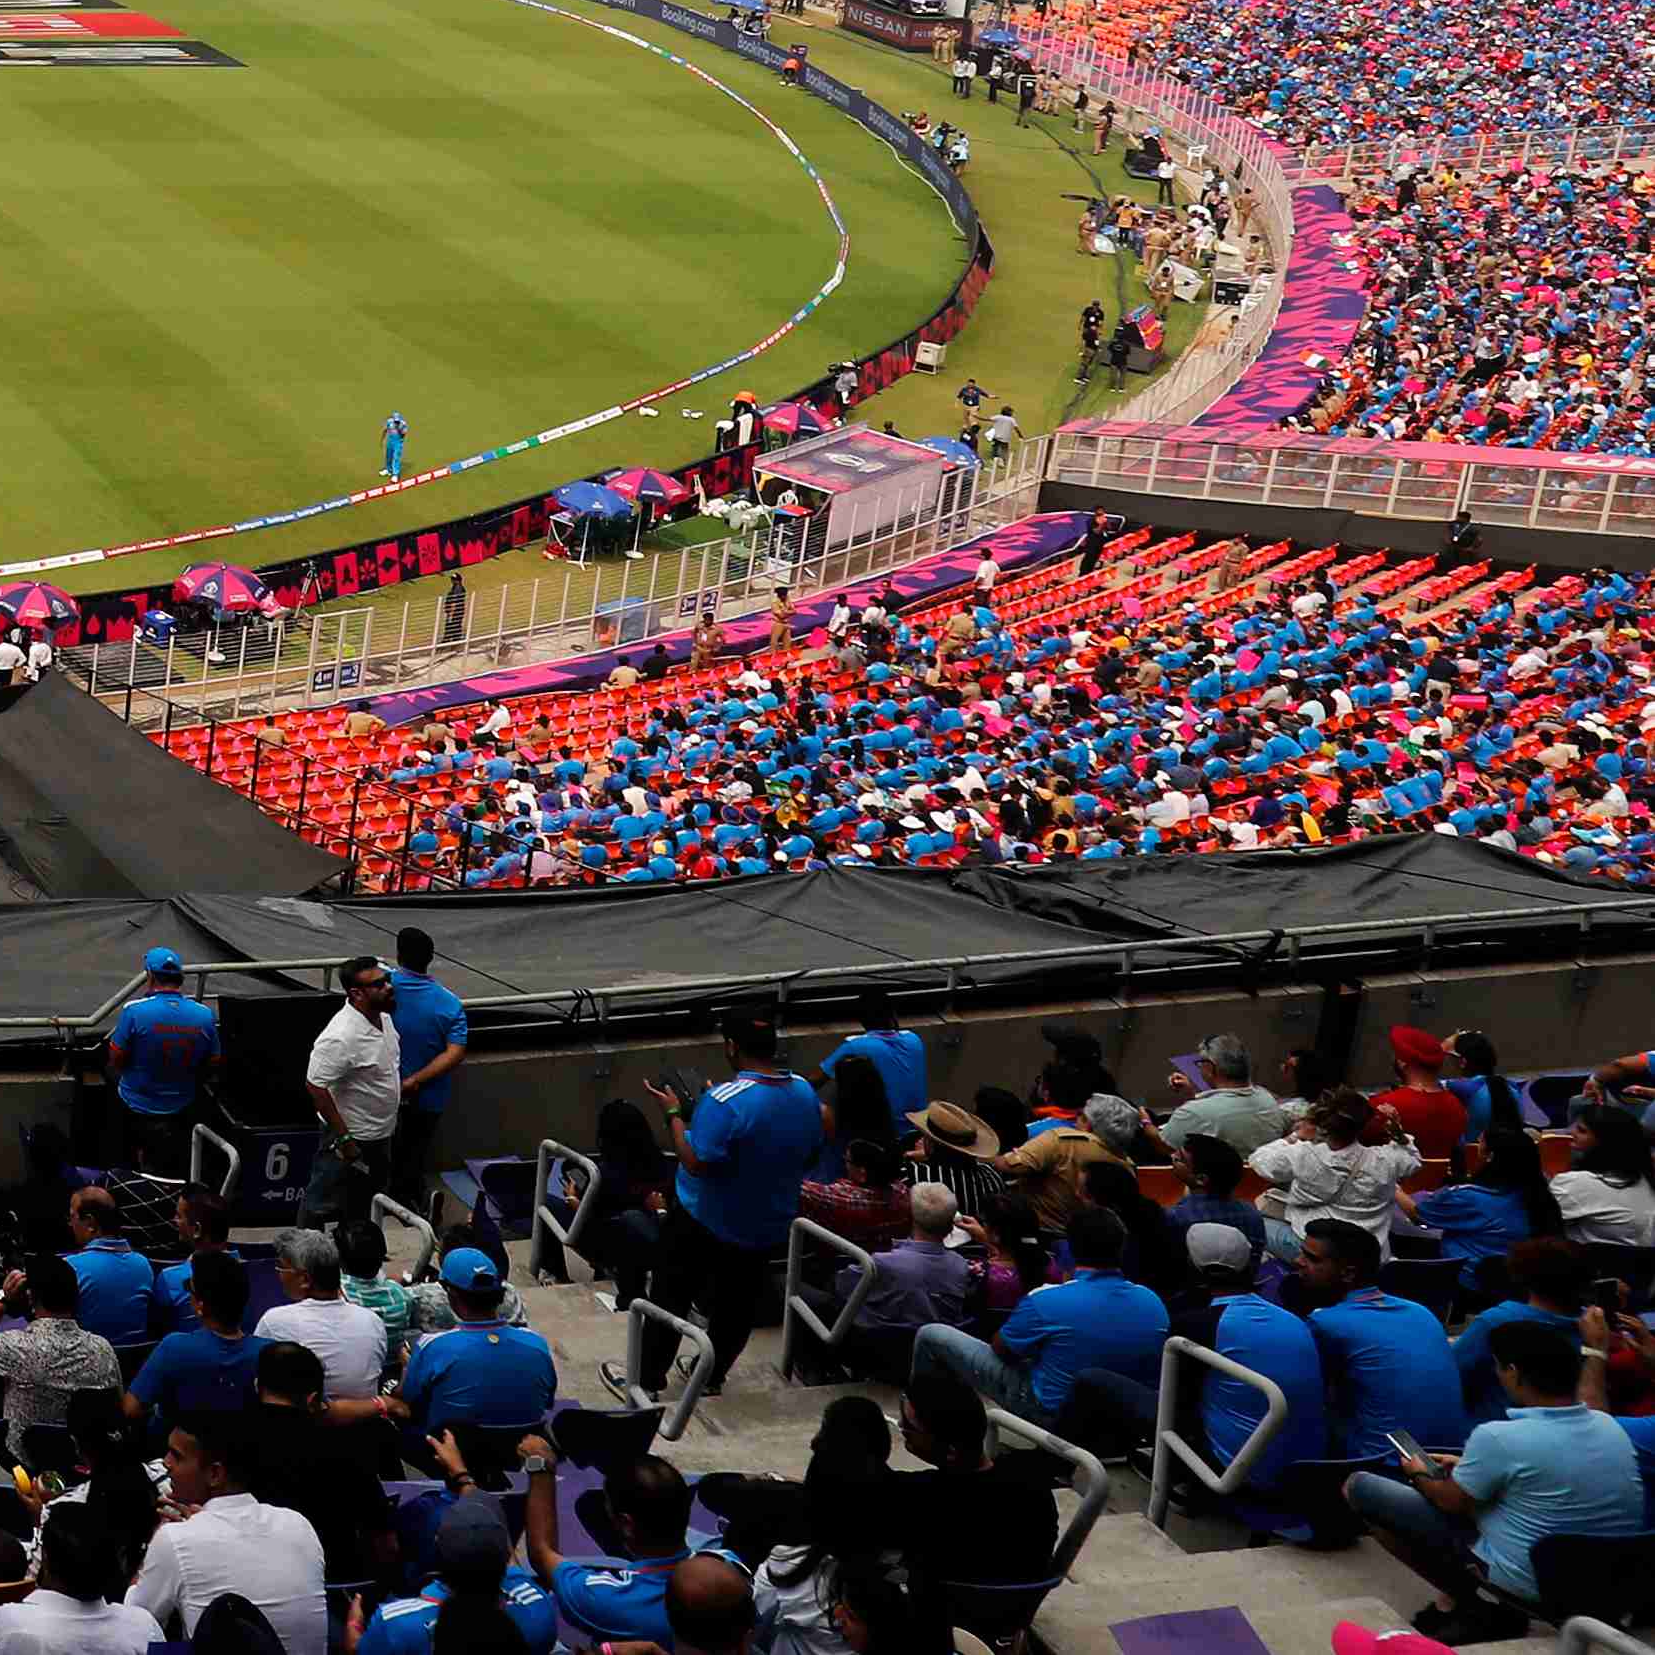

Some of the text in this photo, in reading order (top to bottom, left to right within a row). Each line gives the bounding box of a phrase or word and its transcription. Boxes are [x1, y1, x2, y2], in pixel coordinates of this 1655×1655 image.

[661, 5, 717, 38] Booking.com
[847, 4, 909, 39] NISSAN
[265, 1143, 290, 1181] 6
